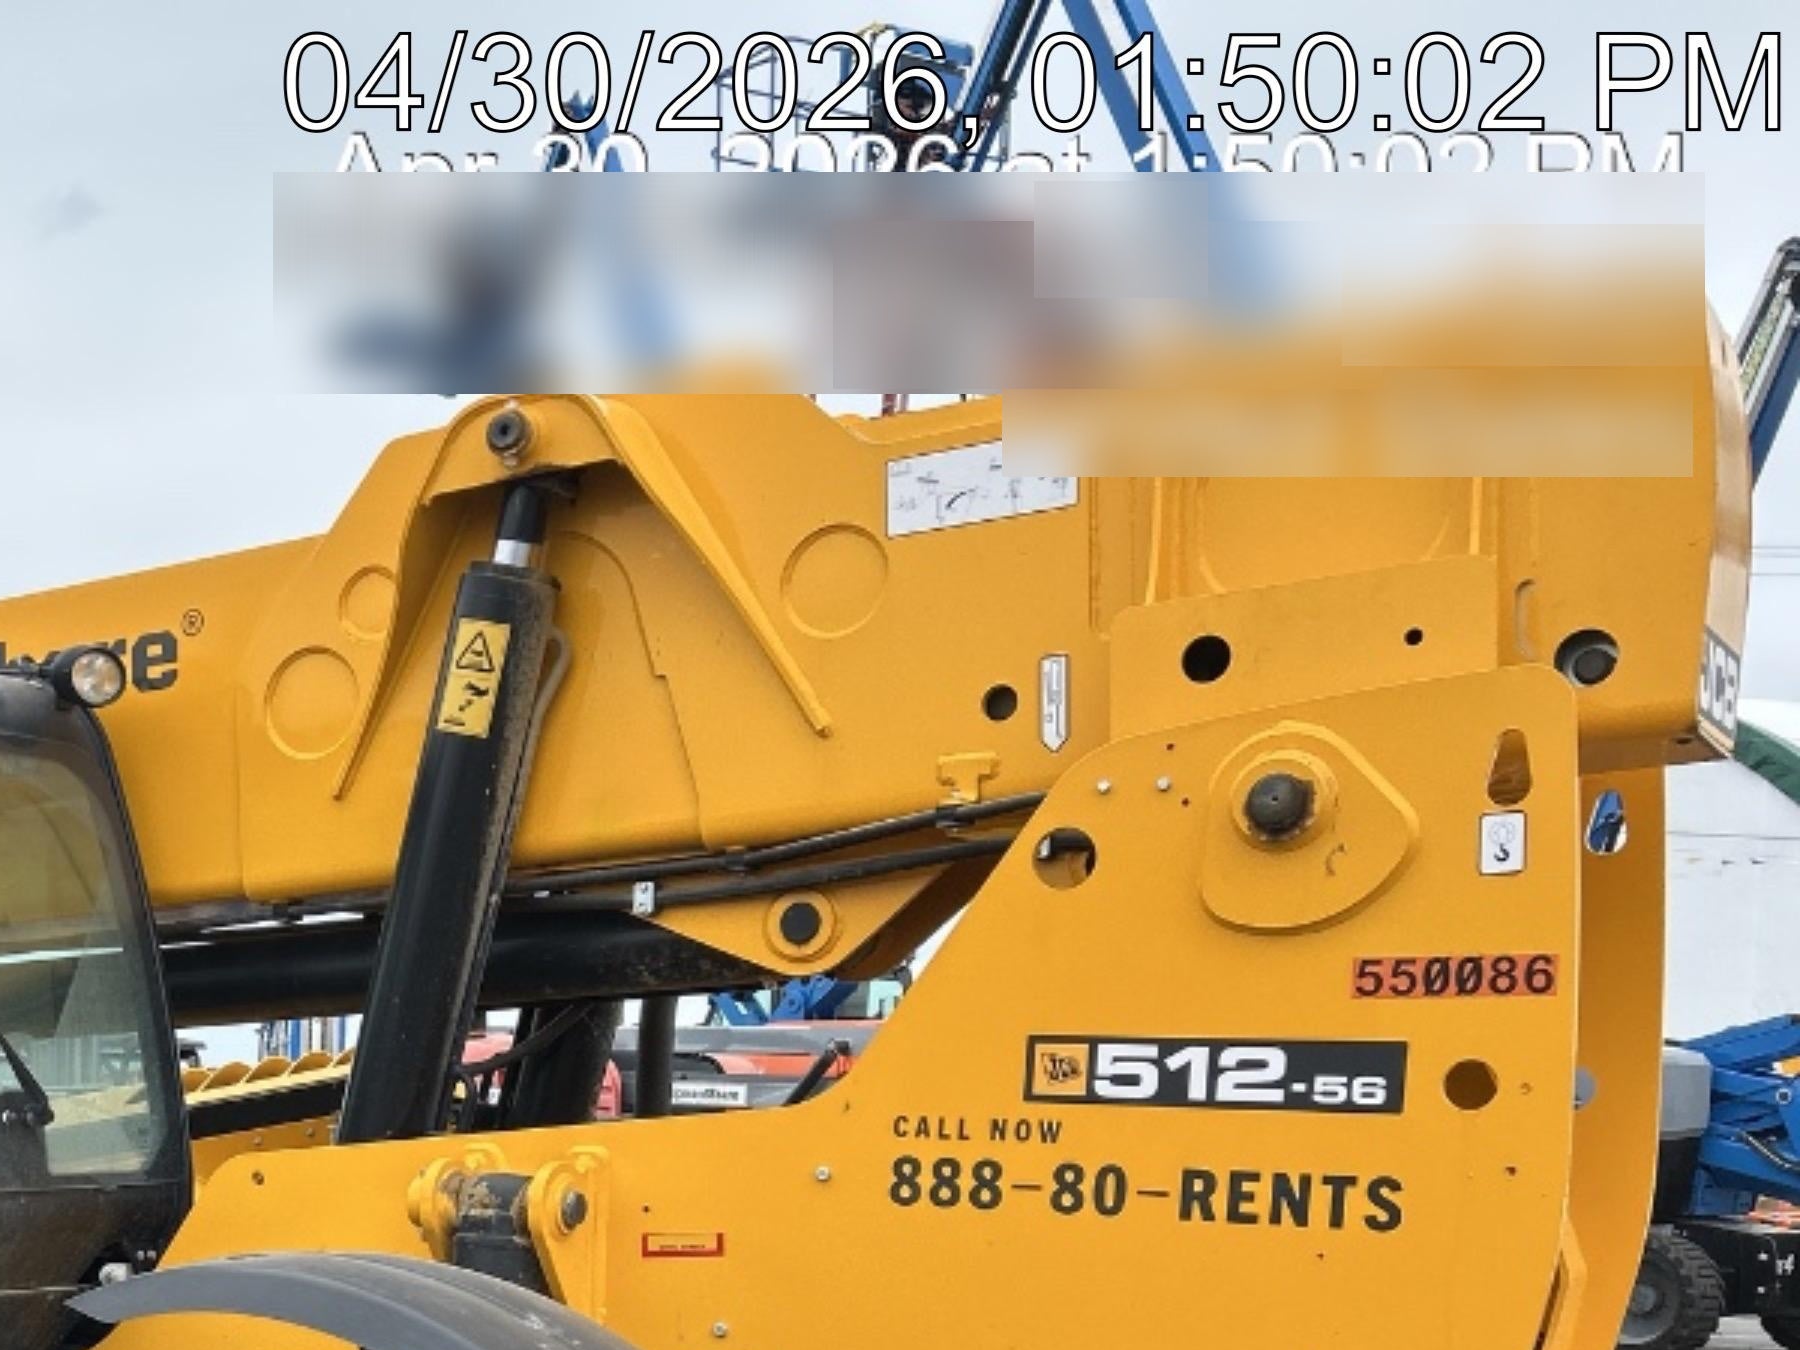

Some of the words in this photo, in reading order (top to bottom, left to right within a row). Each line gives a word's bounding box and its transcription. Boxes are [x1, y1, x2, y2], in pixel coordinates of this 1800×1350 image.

[1353, 954, 1555, 997] 550086
[892, 1115, 971, 1141] CALL
[989, 1119, 1062, 1144] NOW
[888, 1155, 1404, 1232] 888-80-RENTS
